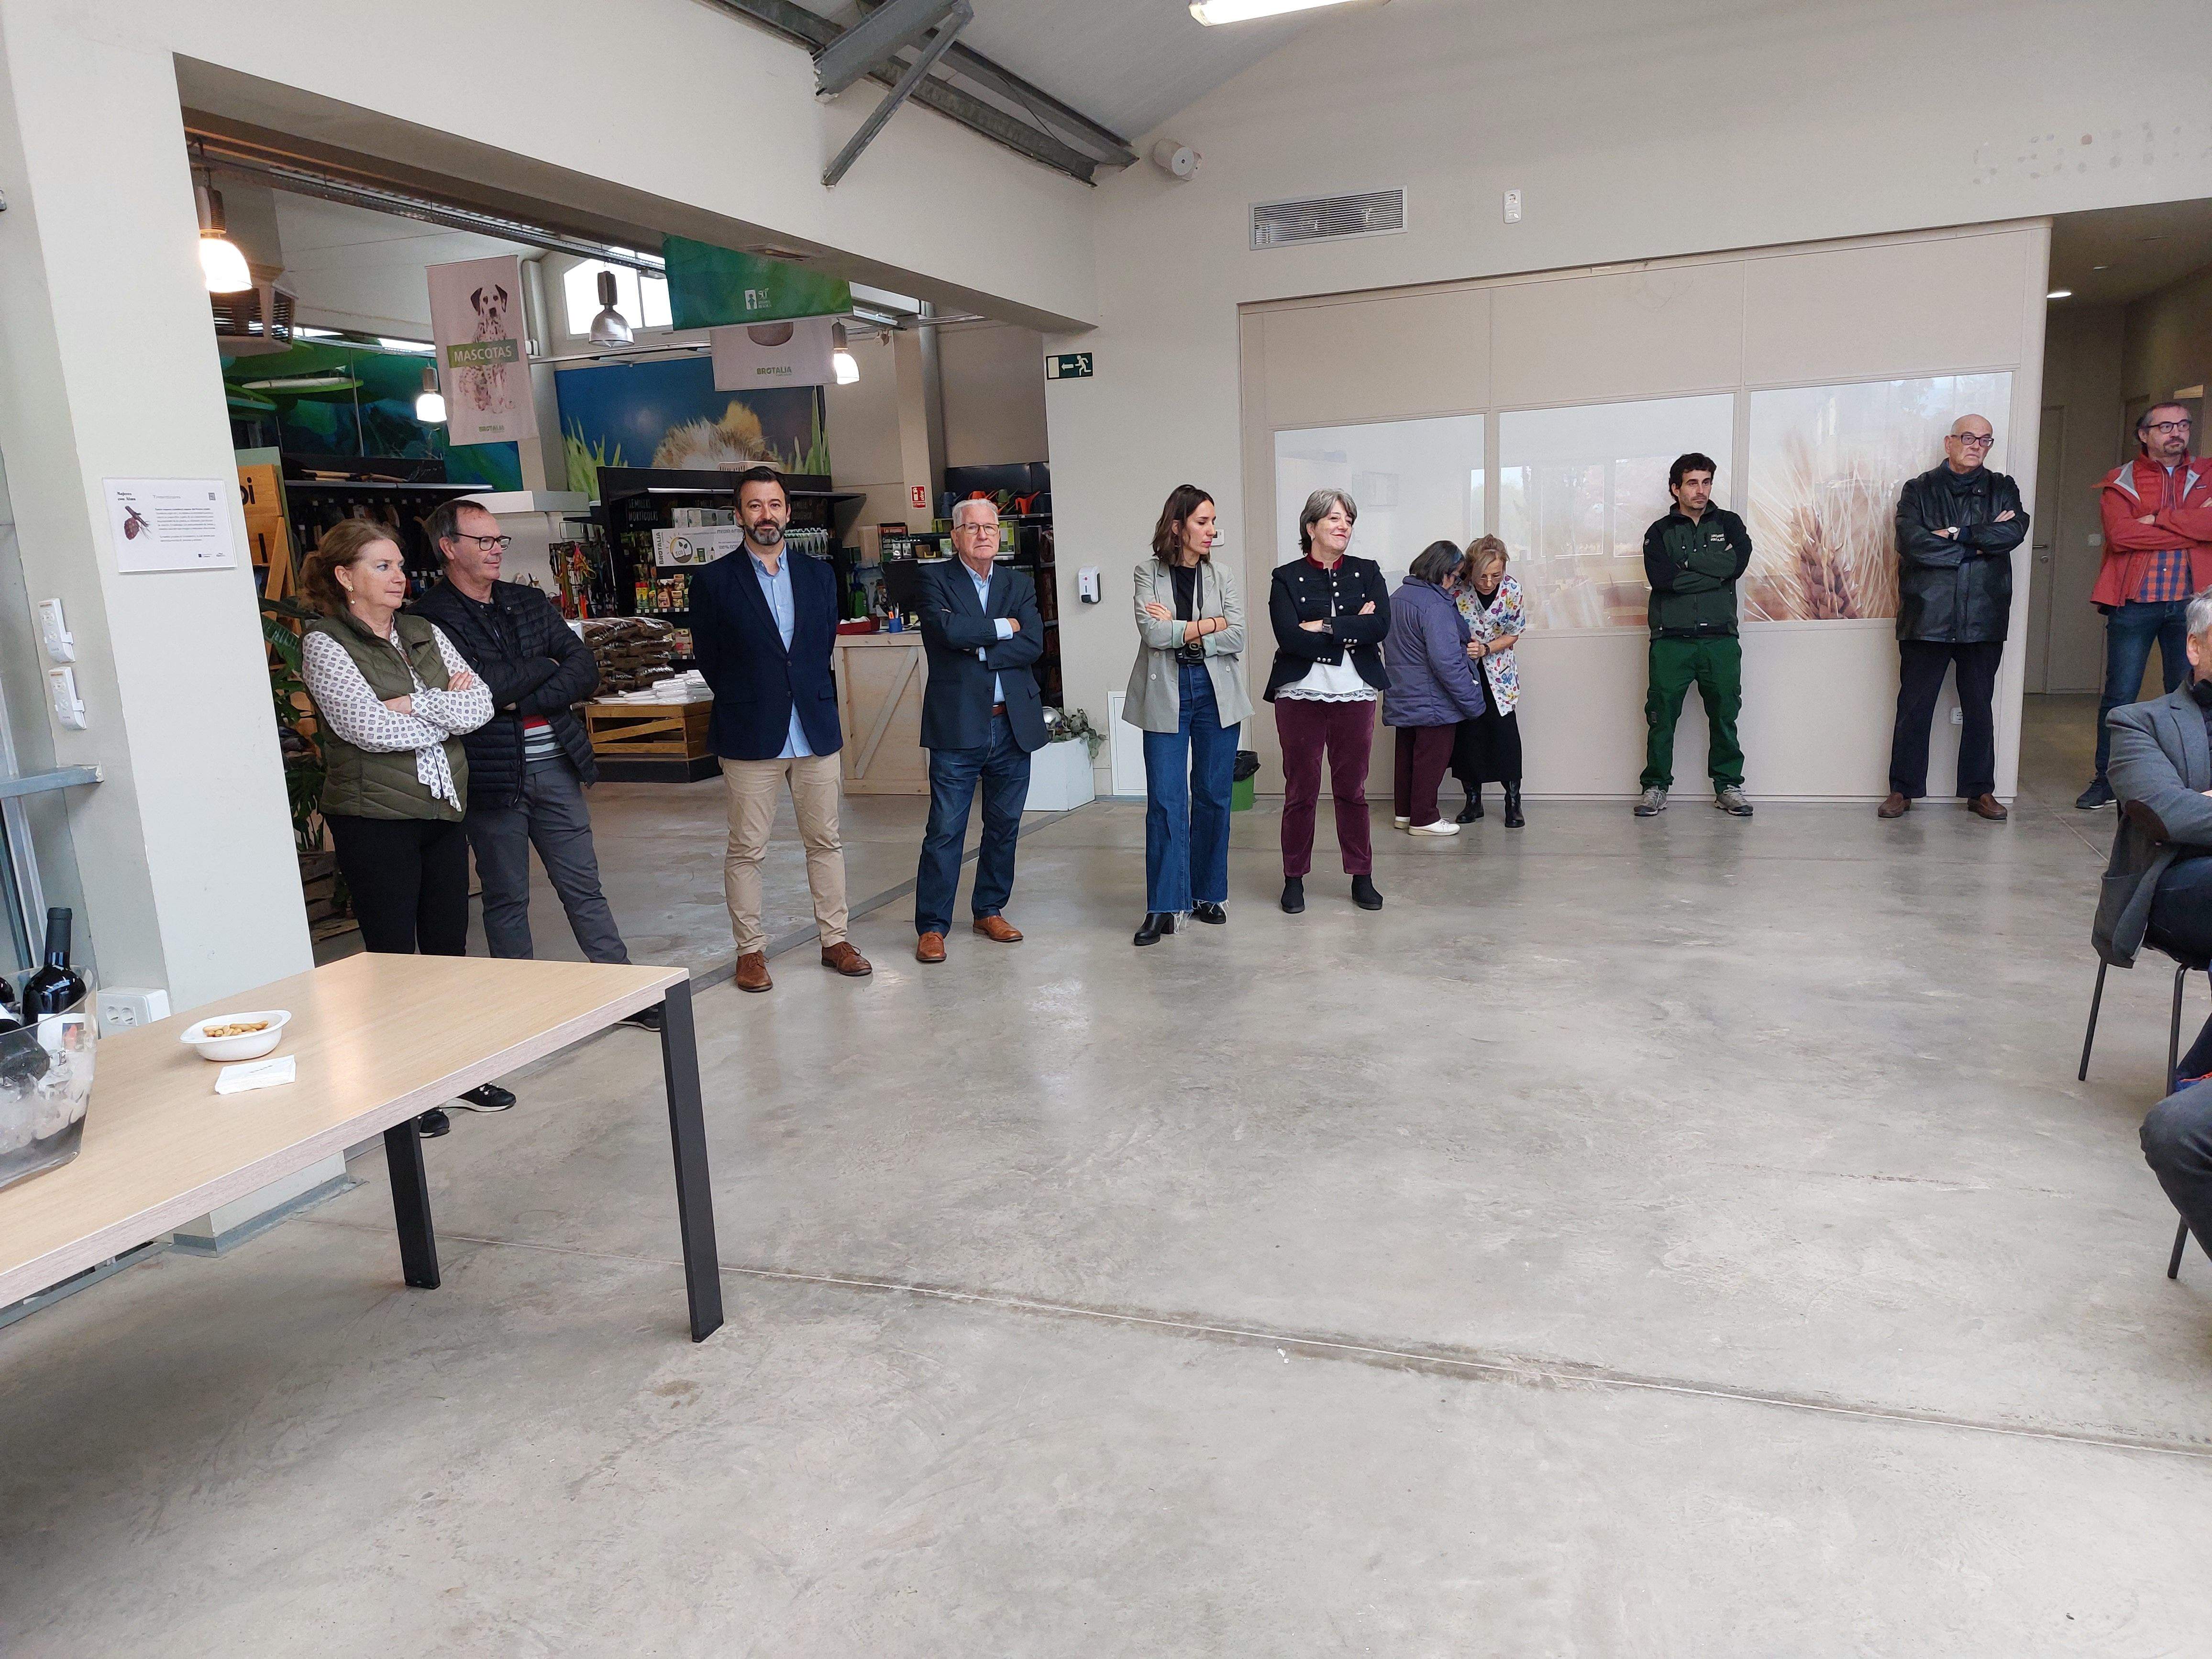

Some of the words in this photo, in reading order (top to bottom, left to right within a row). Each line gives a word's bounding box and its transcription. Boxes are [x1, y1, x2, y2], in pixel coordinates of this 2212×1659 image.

[454, 346, 512, 362] MASCOTAS
[757, 366, 792, 375] BROTALIA
[656, 532, 664, 564] BROTALIA
